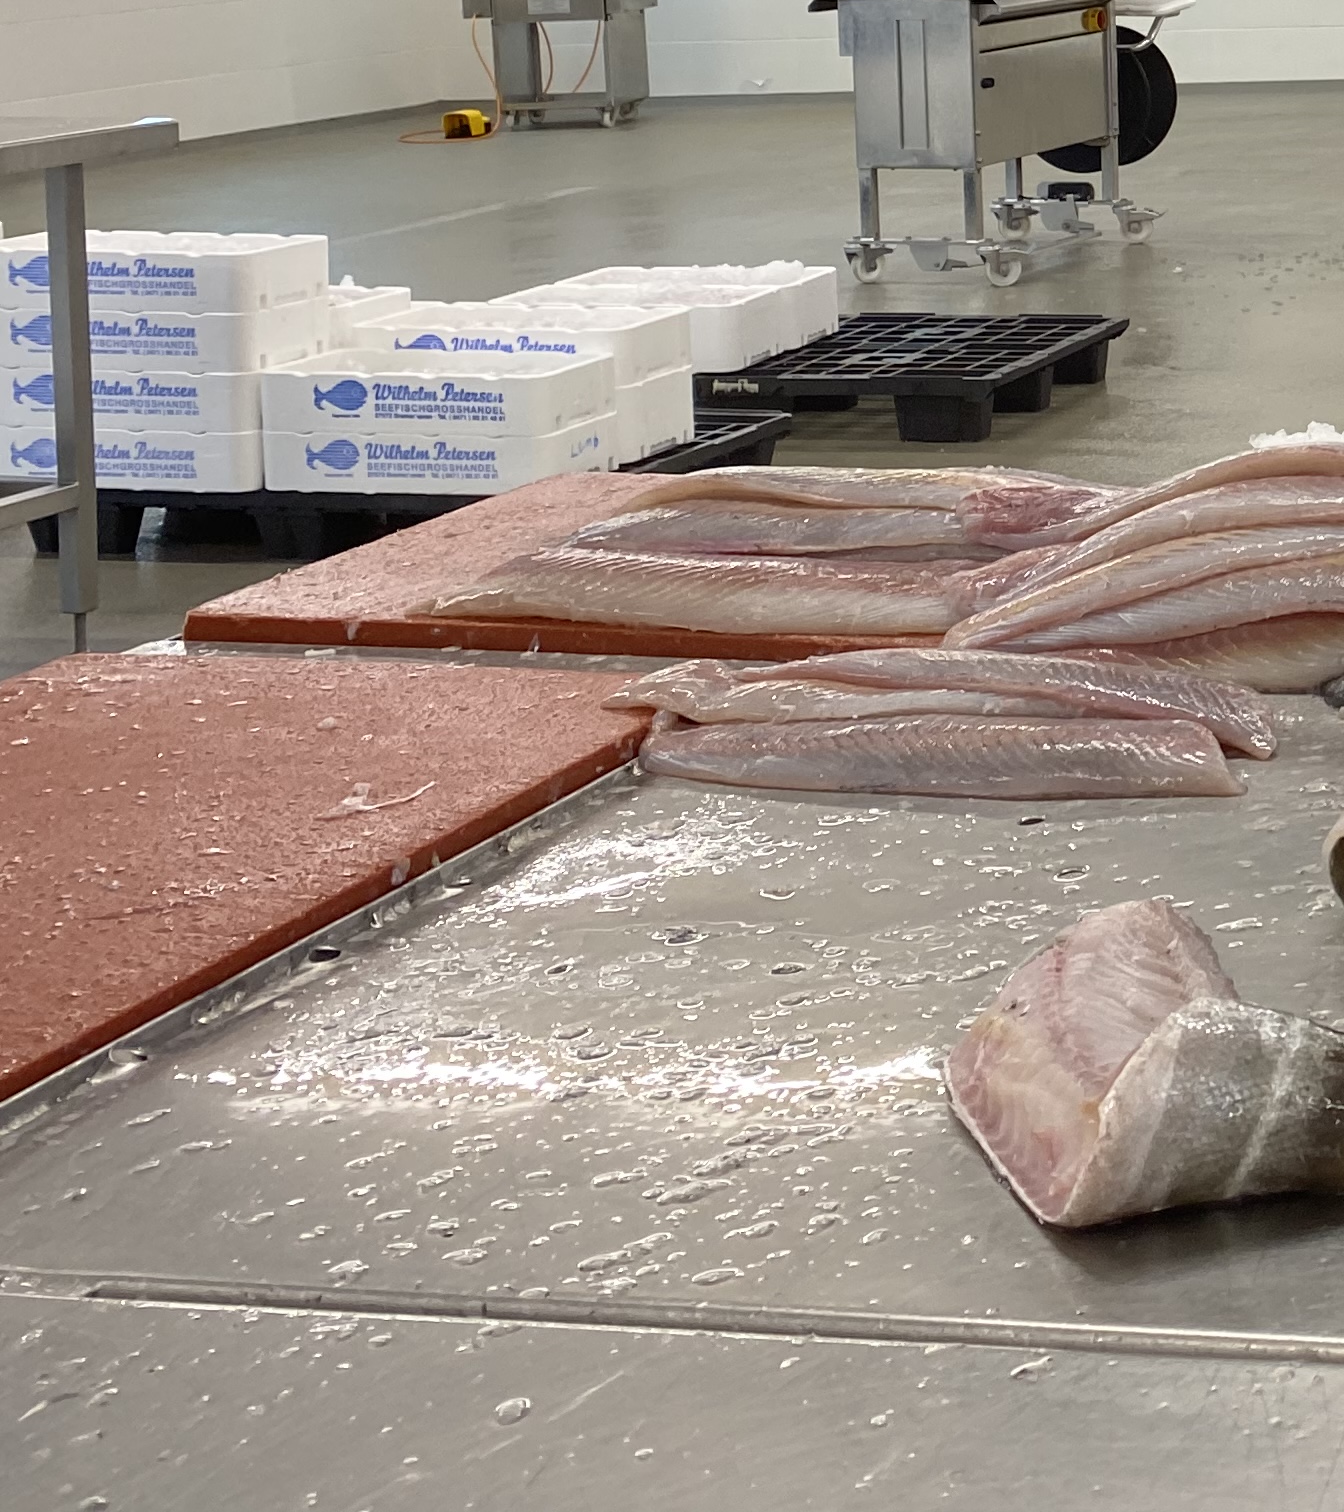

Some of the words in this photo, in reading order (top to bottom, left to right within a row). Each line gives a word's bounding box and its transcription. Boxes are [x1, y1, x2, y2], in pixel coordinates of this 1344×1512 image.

[87, 261, 130, 277] lhelm
[134, 259, 195, 278] Petersen
[89, 320, 132, 337] lhelm
[135, 318, 196, 338] Petersen
[451, 337, 514, 354] Wilhelm
[517, 336, 576, 354] Petersen
[92, 380, 133, 396] lhelm
[137, 378, 198, 397] Petersen
[372, 383, 438, 403] Wilhelm
[441, 382, 504, 403] Petersen
[374, 403, 505, 415] SEEFISCHGROSSHANDEL
[134, 442, 195, 460] Petersen
[365, 442, 430, 461] Wilhelm
[433, 441, 497, 461] Petersen
[367, 462, 497, 473] SEEFISCHGROSSHANDEL
